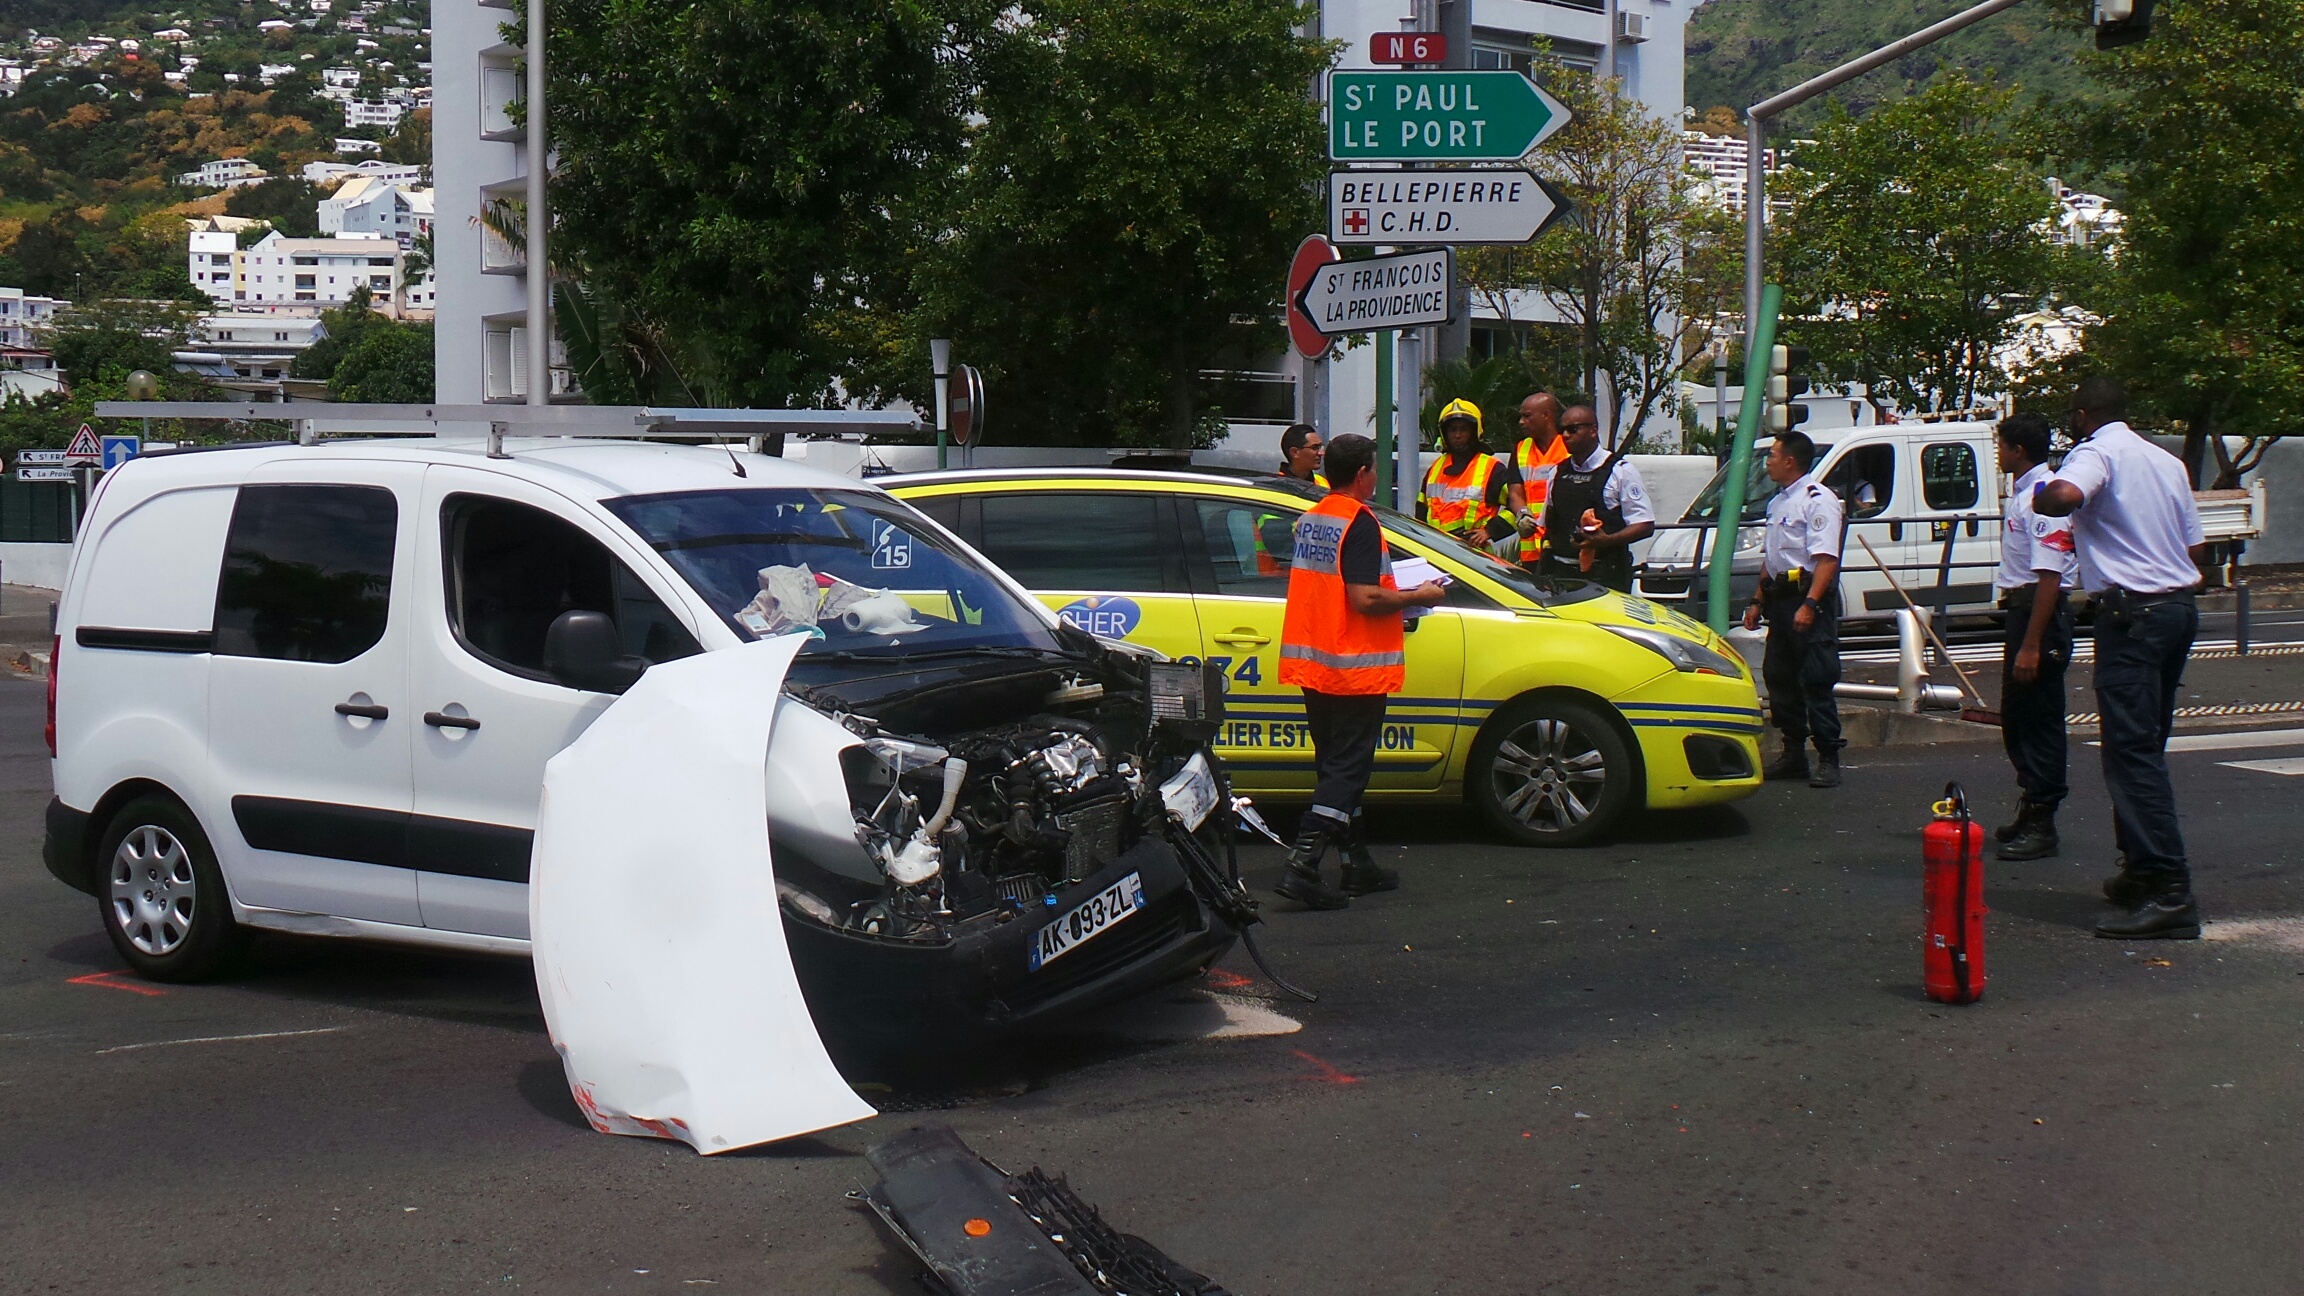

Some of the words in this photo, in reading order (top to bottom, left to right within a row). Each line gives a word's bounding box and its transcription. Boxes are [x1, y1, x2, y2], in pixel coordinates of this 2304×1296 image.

[1390, 37, 1404, 58] N
[1413, 37, 1428, 58] 6
[1345, 84, 1376, 111] ST
[1395, 84, 1480, 111] PAUL
[1344, 120, 1379, 147] LE
[1401, 120, 1487, 147] PORT
[1341, 181, 1522, 203] BELLEPIERRE
[1380, 211, 1461, 233] C.H.D.
[1326, 272, 1345, 295] ST
[1352, 260, 1443, 292] FRANÇOIS
[1326, 301, 1344, 323] LA
[1348, 290, 1443, 321] PROVIDENCE
[1295, 522, 1342, 544] APEURS
[880, 545, 908, 566] 15
[1214, 722, 1262, 748] LIER
[1269, 723, 1310, 748] EST
